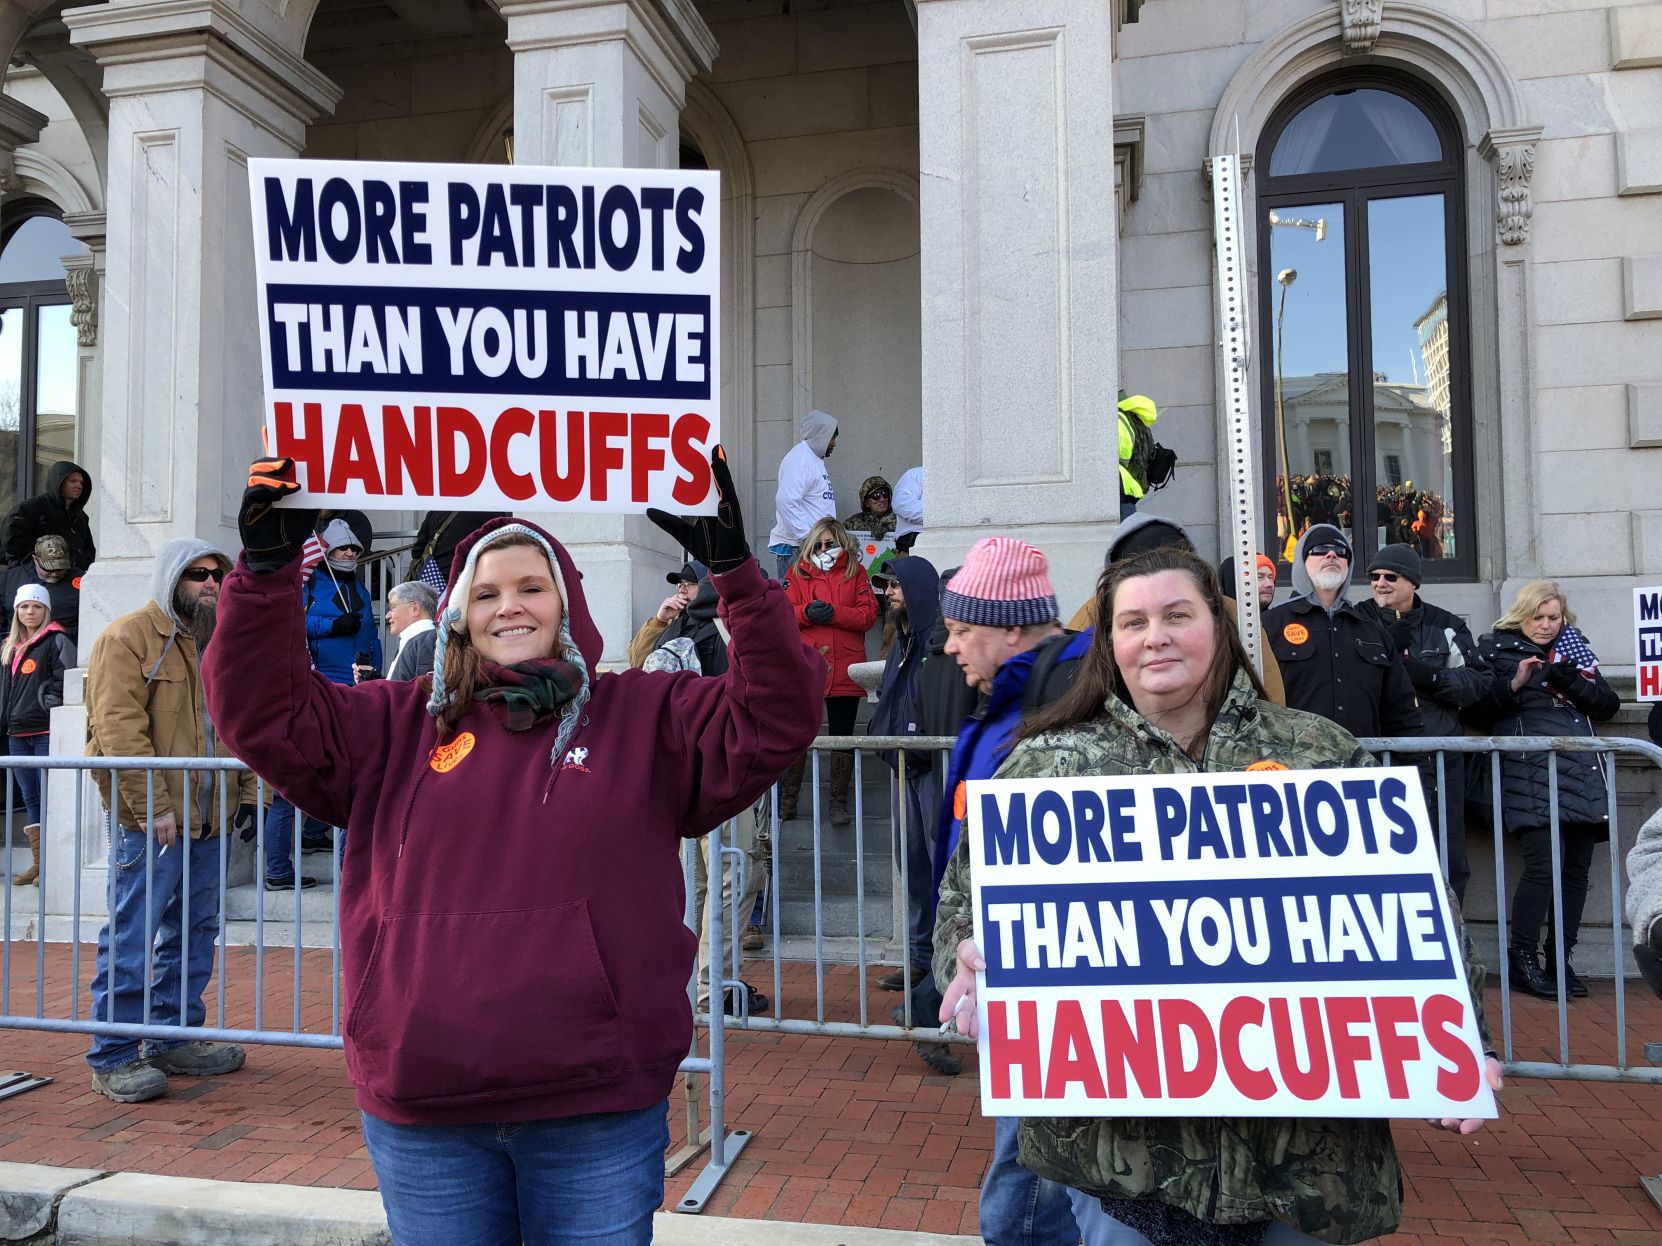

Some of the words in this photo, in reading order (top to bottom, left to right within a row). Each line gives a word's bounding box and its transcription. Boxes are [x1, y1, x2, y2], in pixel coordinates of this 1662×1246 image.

[264, 177, 432, 265] MORE
[448, 182, 705, 274] PATRIOTS
[274, 303, 423, 375] THAN
[436, 307, 548, 379] YOU
[564, 310, 705, 382] HAVE
[274, 402, 711, 507] HANDCUFFS
[1286, 629, 1306, 637] SAVE
[1640, 593, 1662, 620] M
[1640, 665, 1662, 696] H
[432, 739, 472, 763] SAVE
[442, 735, 466, 752] Guns
[981, 789, 1143, 866] MORE
[1153, 777, 1418, 861] PATRIOTS
[987, 900, 1140, 970] THAN
[1149, 896, 1271, 966] YOU
[1282, 892, 1446, 964] HAVE
[987, 993, 1481, 1102] HANDCUFFS
